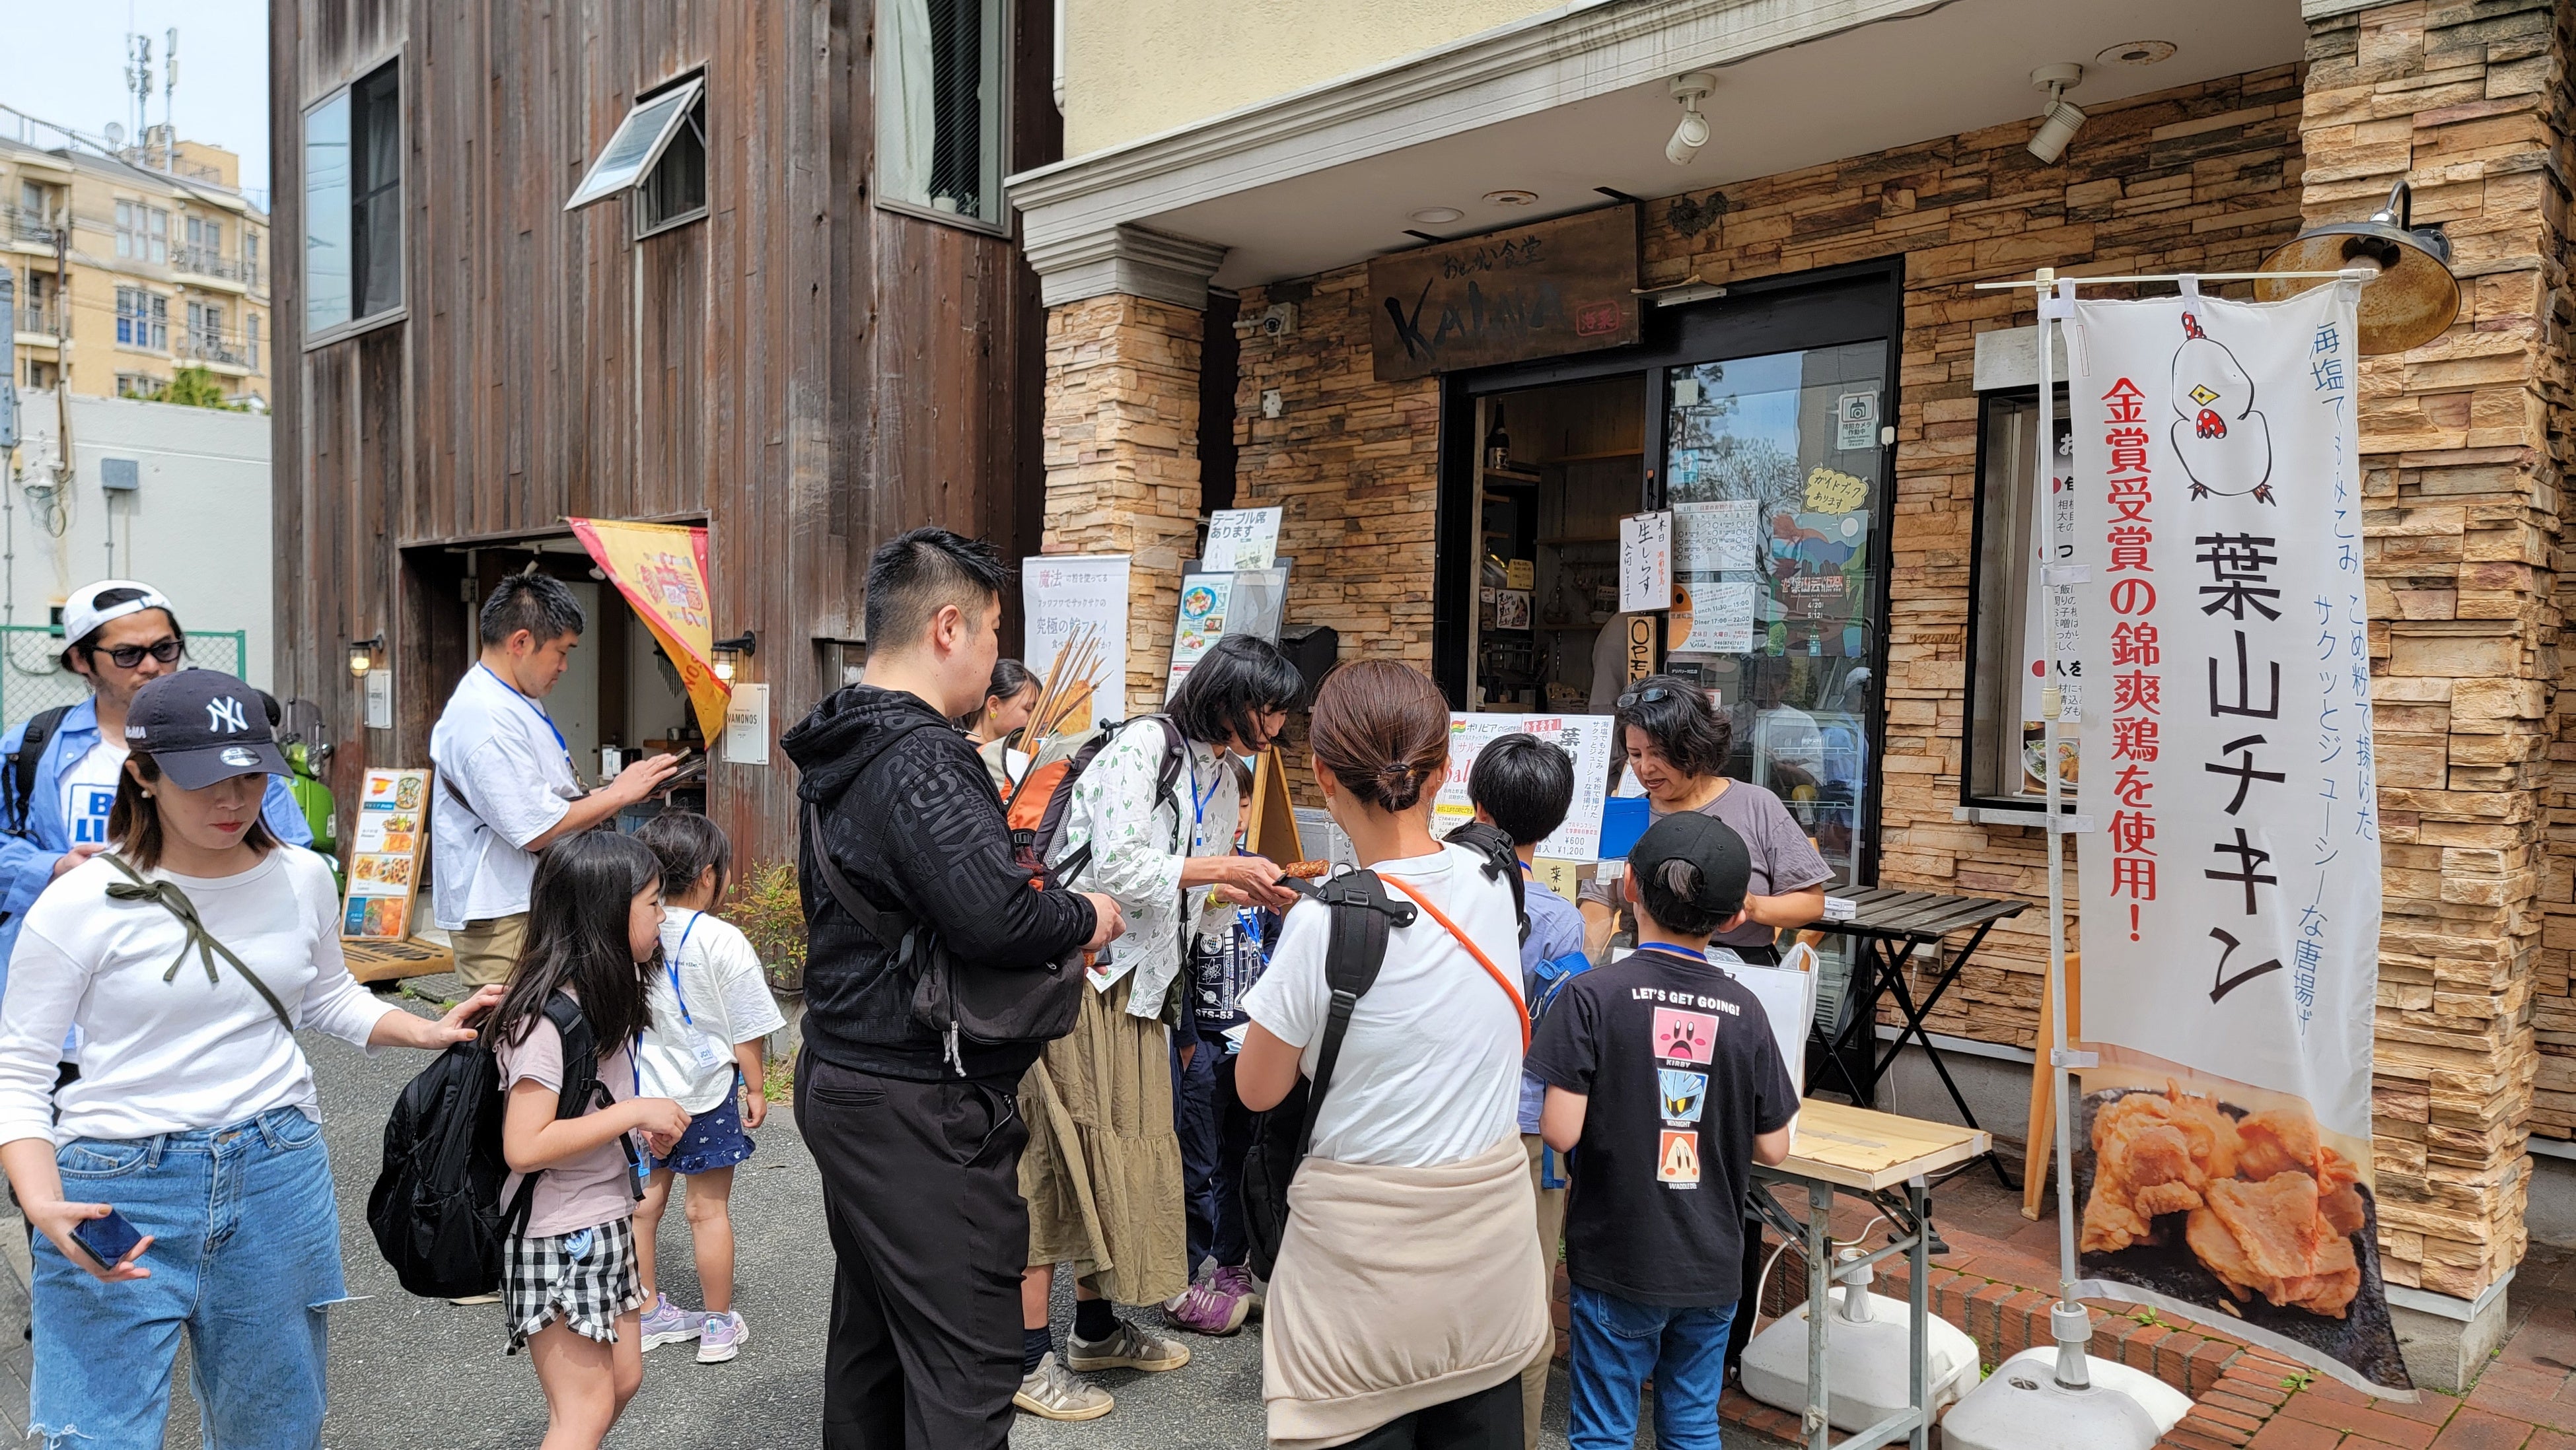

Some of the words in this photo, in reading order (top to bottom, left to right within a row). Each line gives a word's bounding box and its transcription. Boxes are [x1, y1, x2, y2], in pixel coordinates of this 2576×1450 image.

[1814, 475, 1861, 499] ガイドブック
[1813, 491, 1843, 509] あります
[1213, 511, 1268, 526] テーブル席
[1211, 525, 1254, 539] あります
[1657, 516, 1667, 542] 本日
[1638, 522, 1653, 598] 生しらす
[1039, 569, 1062, 588] 魔法
[2309, 321, 2359, 574] 海塩でもみこみ
[2349, 595, 2374, 842] こめ粉で揚げた
[2100, 376, 2161, 942] 金賞受賞の錦爽鶏を使用！
[205, 695, 249, 734] NY
[727, 713, 758, 725] VAMONOS
[2195, 532, 2287, 1005] 葉山チキン
[1565, 836, 1585, 846] ¥600
[1557, 846, 1585, 856] ¥1,200
[1631, 988, 1666, 1001] LET'S
[1669, 992, 1694, 1006] GET
[1698, 996, 1740, 1016] GOING!
[1196, 1009, 1234, 1019] STS-53
[1666, 1059, 1691, 1068] KIRBY
